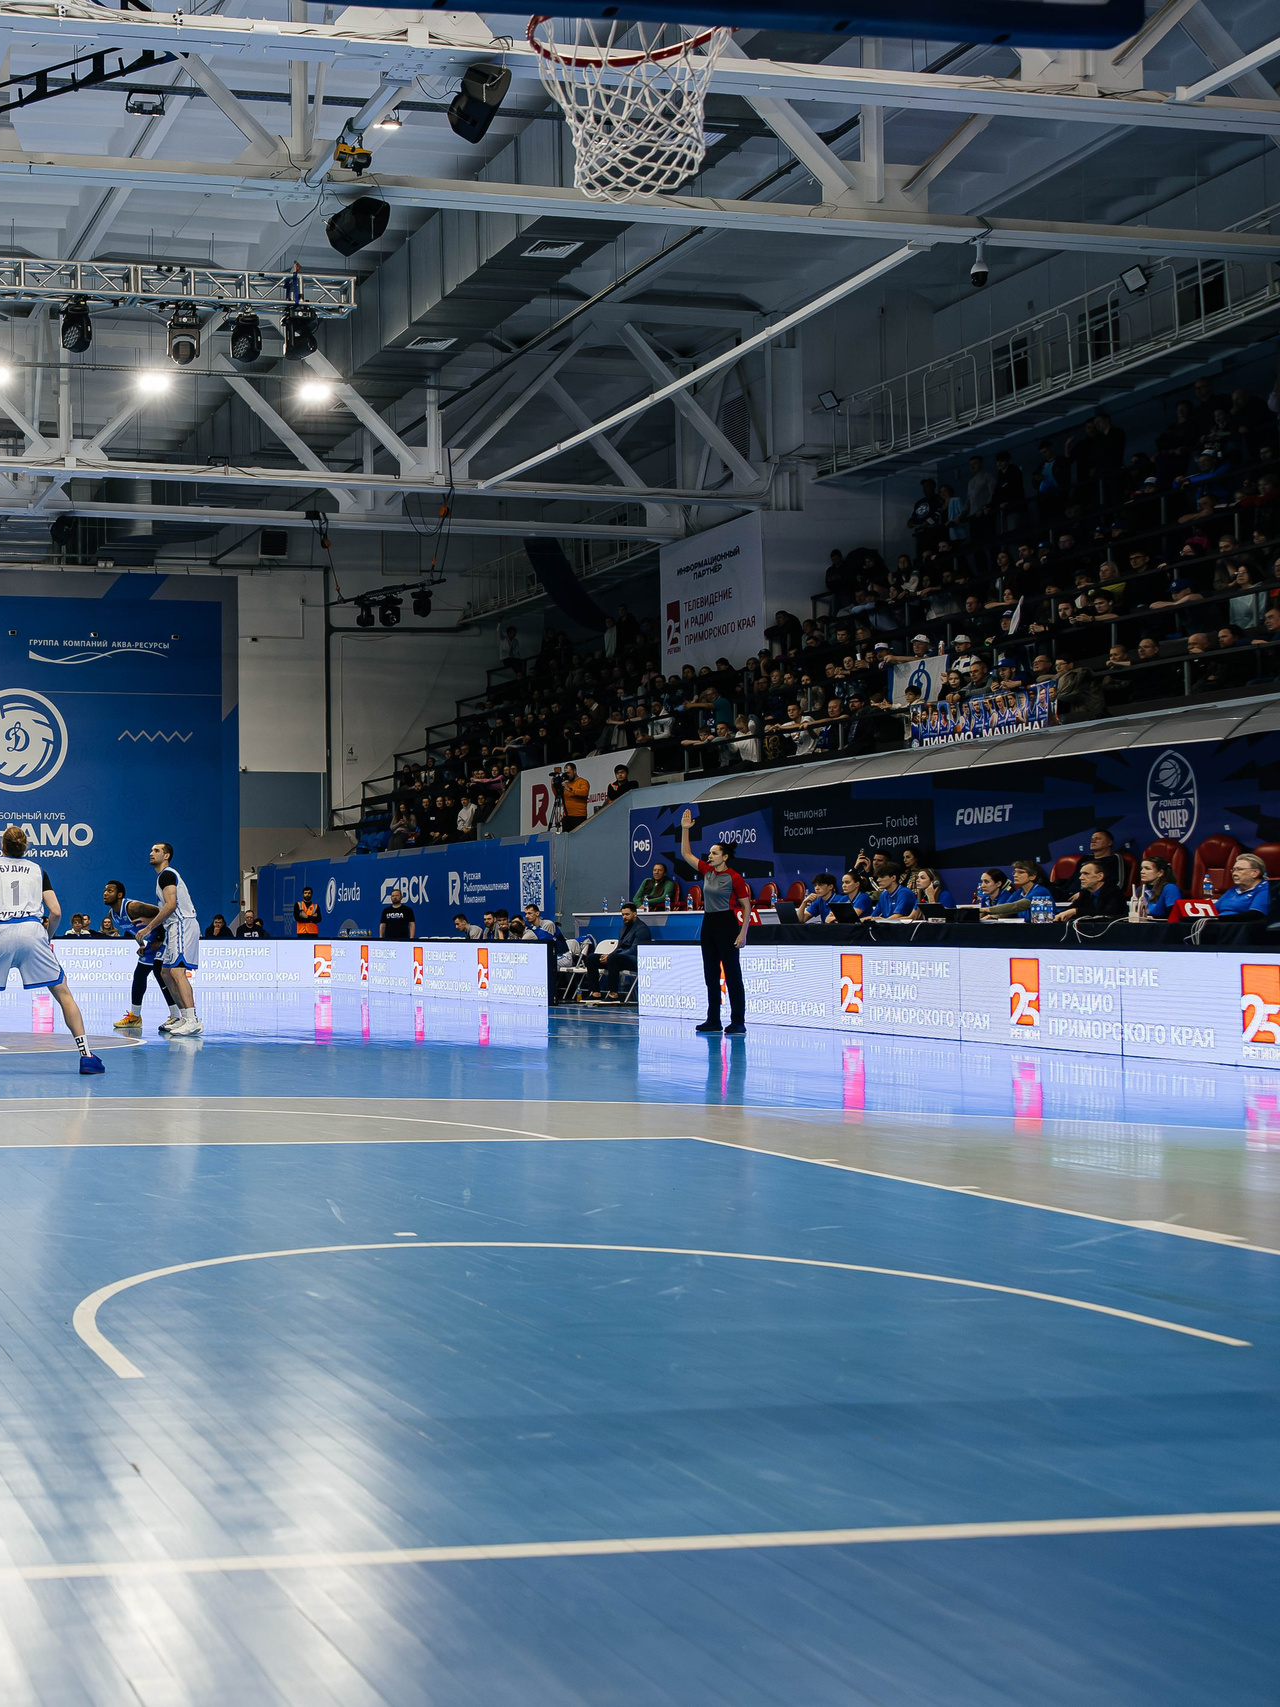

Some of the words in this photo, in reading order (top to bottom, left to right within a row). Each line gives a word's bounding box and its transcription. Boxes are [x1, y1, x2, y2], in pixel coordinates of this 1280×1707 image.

[676, 546, 740, 576] ИНФОРМАЦИОННЫЙ
[684, 587, 733, 613] ТЕЛЕВИДЕНИЕ
[684, 619, 689, 630] И
[690, 611, 714, 628] РАДИО
[684, 621, 736, 646] ПРИМОРСКОГО
[737, 616, 756, 632] КРАЯ
[63, 640, 108, 648] КОМПАНИЙ
[112, 641, 170, 650] АКВА-РЕСУРСЫ
[923, 731, 974, 747] ДИНАМО
[982, 721, 1045, 738] МАШИНА!
[1159, 798, 1186, 808] FONBET
[44, 812, 66, 821] КЛУБ
[784, 808, 828, 821] Чемпионат
[955, 804, 1013, 826] FONBET
[1158, 808, 1188, 829] СУПЕР
[784, 824, 814, 836] России
[885, 814, 918, 828] Fonbet
[718, 828, 757, 845] 2025/26
[868, 834, 920, 849] Суперлига
[40, 849, 68, 858] КРАЙ
[634, 839, 650, 853] РФБ
[463, 871, 481, 882] Русская
[10, 880, 20, 906] 1
[338, 882, 360, 902] slavda
[464, 895, 486, 904] Компания
[60, 947, 130, 958] ТЕЛЕВИДЕНИЕ
[201, 947, 270, 957] ТЕЛЕВИДЕНИЕ
[425, 950, 456, 962] ТЕЛЕВИДЕНИЕ
[491, 952, 528, 965] ТЕЛЕВИДЕНИЕ
[70, 960, 103, 970] РАДИО
[202, 960, 208, 968] И
[210, 960, 244, 970] РАДИО
[638, 956, 672, 971] ВИДЕНИЕ
[741, 958, 796, 975] ЛЕВИДЕНИЕ
[869, 960, 950, 980] ТЕЛЕВИДЕНИЕ
[68, 972, 133, 982] РИМОРСКОГО
[201, 972, 274, 982] ПРИМОРСКОГО
[277, 973, 300, 982] КРАЯ
[430, 966, 444, 977] РАДИО
[496, 968, 514, 980] РАДИО
[1048, 964, 1159, 988] ТЕЛЕВИДЕНИЕ
[425, 980, 458, 992] ПРИМОРСКОГО
[460, 982, 472, 992] КРАЯ
[492, 984, 530, 997] ПРИМОРСКОГО
[532, 986, 546, 998] КРАЯ
[744, 978, 770, 994] АДИО
[870, 984, 878, 998] И
[879, 984, 918, 1002] РАДИО
[840, 976, 864, 1013] 25
[676, 996, 697, 1010] КРАЯ
[746, 999, 798, 1016] ИМОРСКОГО
[801, 1002, 826, 1017] КРАЯ
[1010, 983, 1040, 1026] 25
[1048, 992, 1058, 1009] И
[1062, 992, 1113, 1015] РАДИО
[841, 1014, 864, 1026] РЕГИОН
[870, 1006, 954, 1027] ПРИМОРСКОГО
[958, 1012, 990, 1030] КРАЯ
[1240, 994, 1280, 1044] 25
[1010, 1028, 1040, 1040] РЕГИОН
[1048, 1017, 1166, 1045] ПРИМОРСКОГО
[1170, 1026, 1215, 1048] КРАЯ
